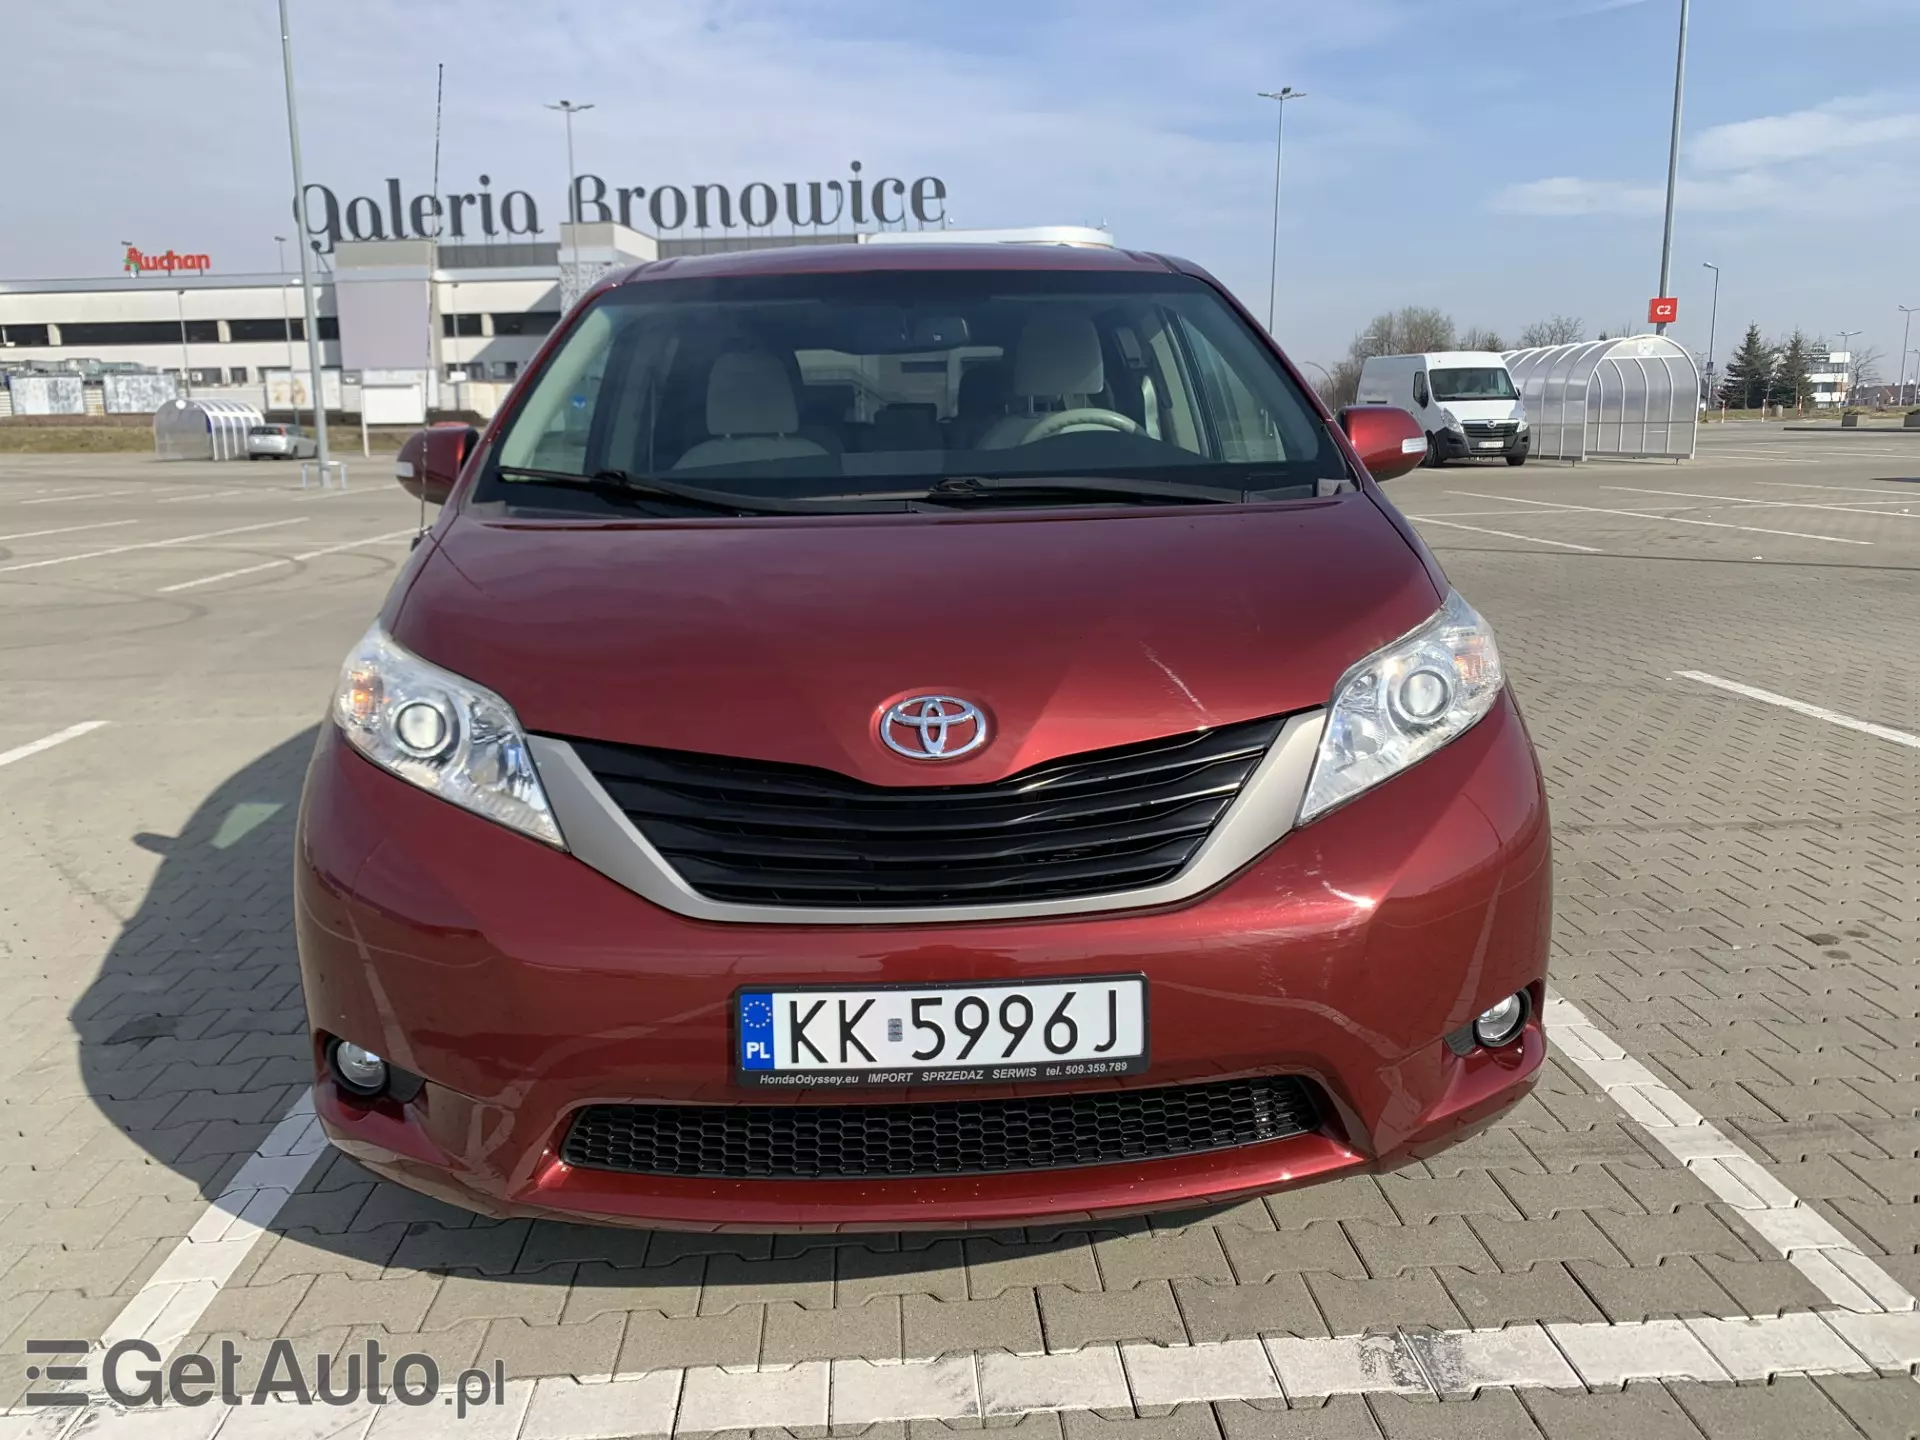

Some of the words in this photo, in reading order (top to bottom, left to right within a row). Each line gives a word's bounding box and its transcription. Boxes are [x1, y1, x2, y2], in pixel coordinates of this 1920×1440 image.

[569, 160, 946, 229] Bronowice
[124, 247, 210, 272] Auchan
[1656, 305, 1671, 315] C2
[746, 1042, 770, 1059] PL
[790, 999, 877, 1063] KK
[911, 990, 1117, 1060] 5996J
[760, 1074, 859, 1085] HondaOdyssey.eu
[868, 1072, 913, 1083] IMPORT
[992, 1067, 1037, 1079] SERWIS
[1046, 1065, 1062, 1076] tel.
[1065, 1062, 1127, 1075] 509.359.789
